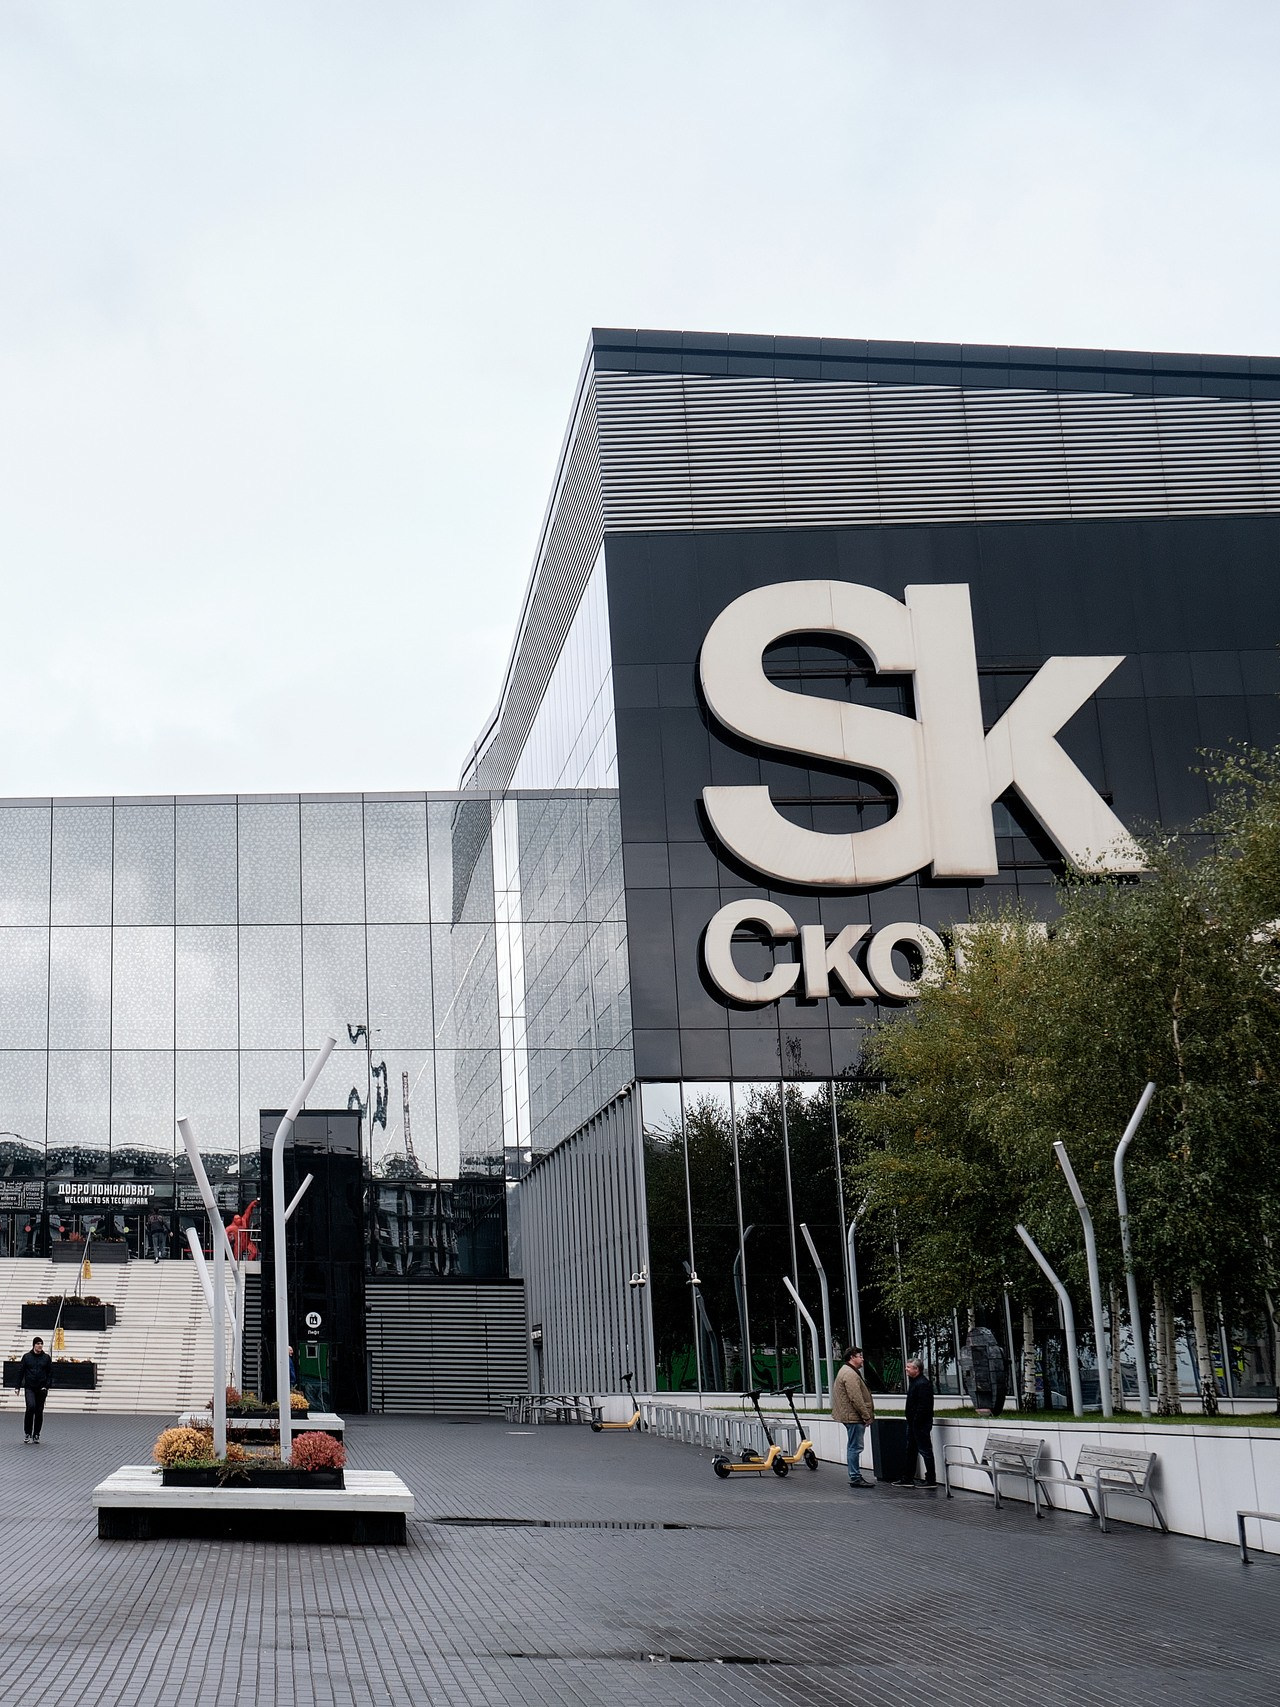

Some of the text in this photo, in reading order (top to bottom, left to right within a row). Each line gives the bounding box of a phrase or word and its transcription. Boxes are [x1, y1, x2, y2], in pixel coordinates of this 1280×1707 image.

[700, 580, 1151, 886] Sk
[58, 1184, 155, 1195] ДОБРО ПОЖАЛОВАТЬ
[64, 1196, 93, 1204] WELCOME
[94, 1196, 101, 1204] TO
[111, 1197, 149, 1205] TECHNOPARK
